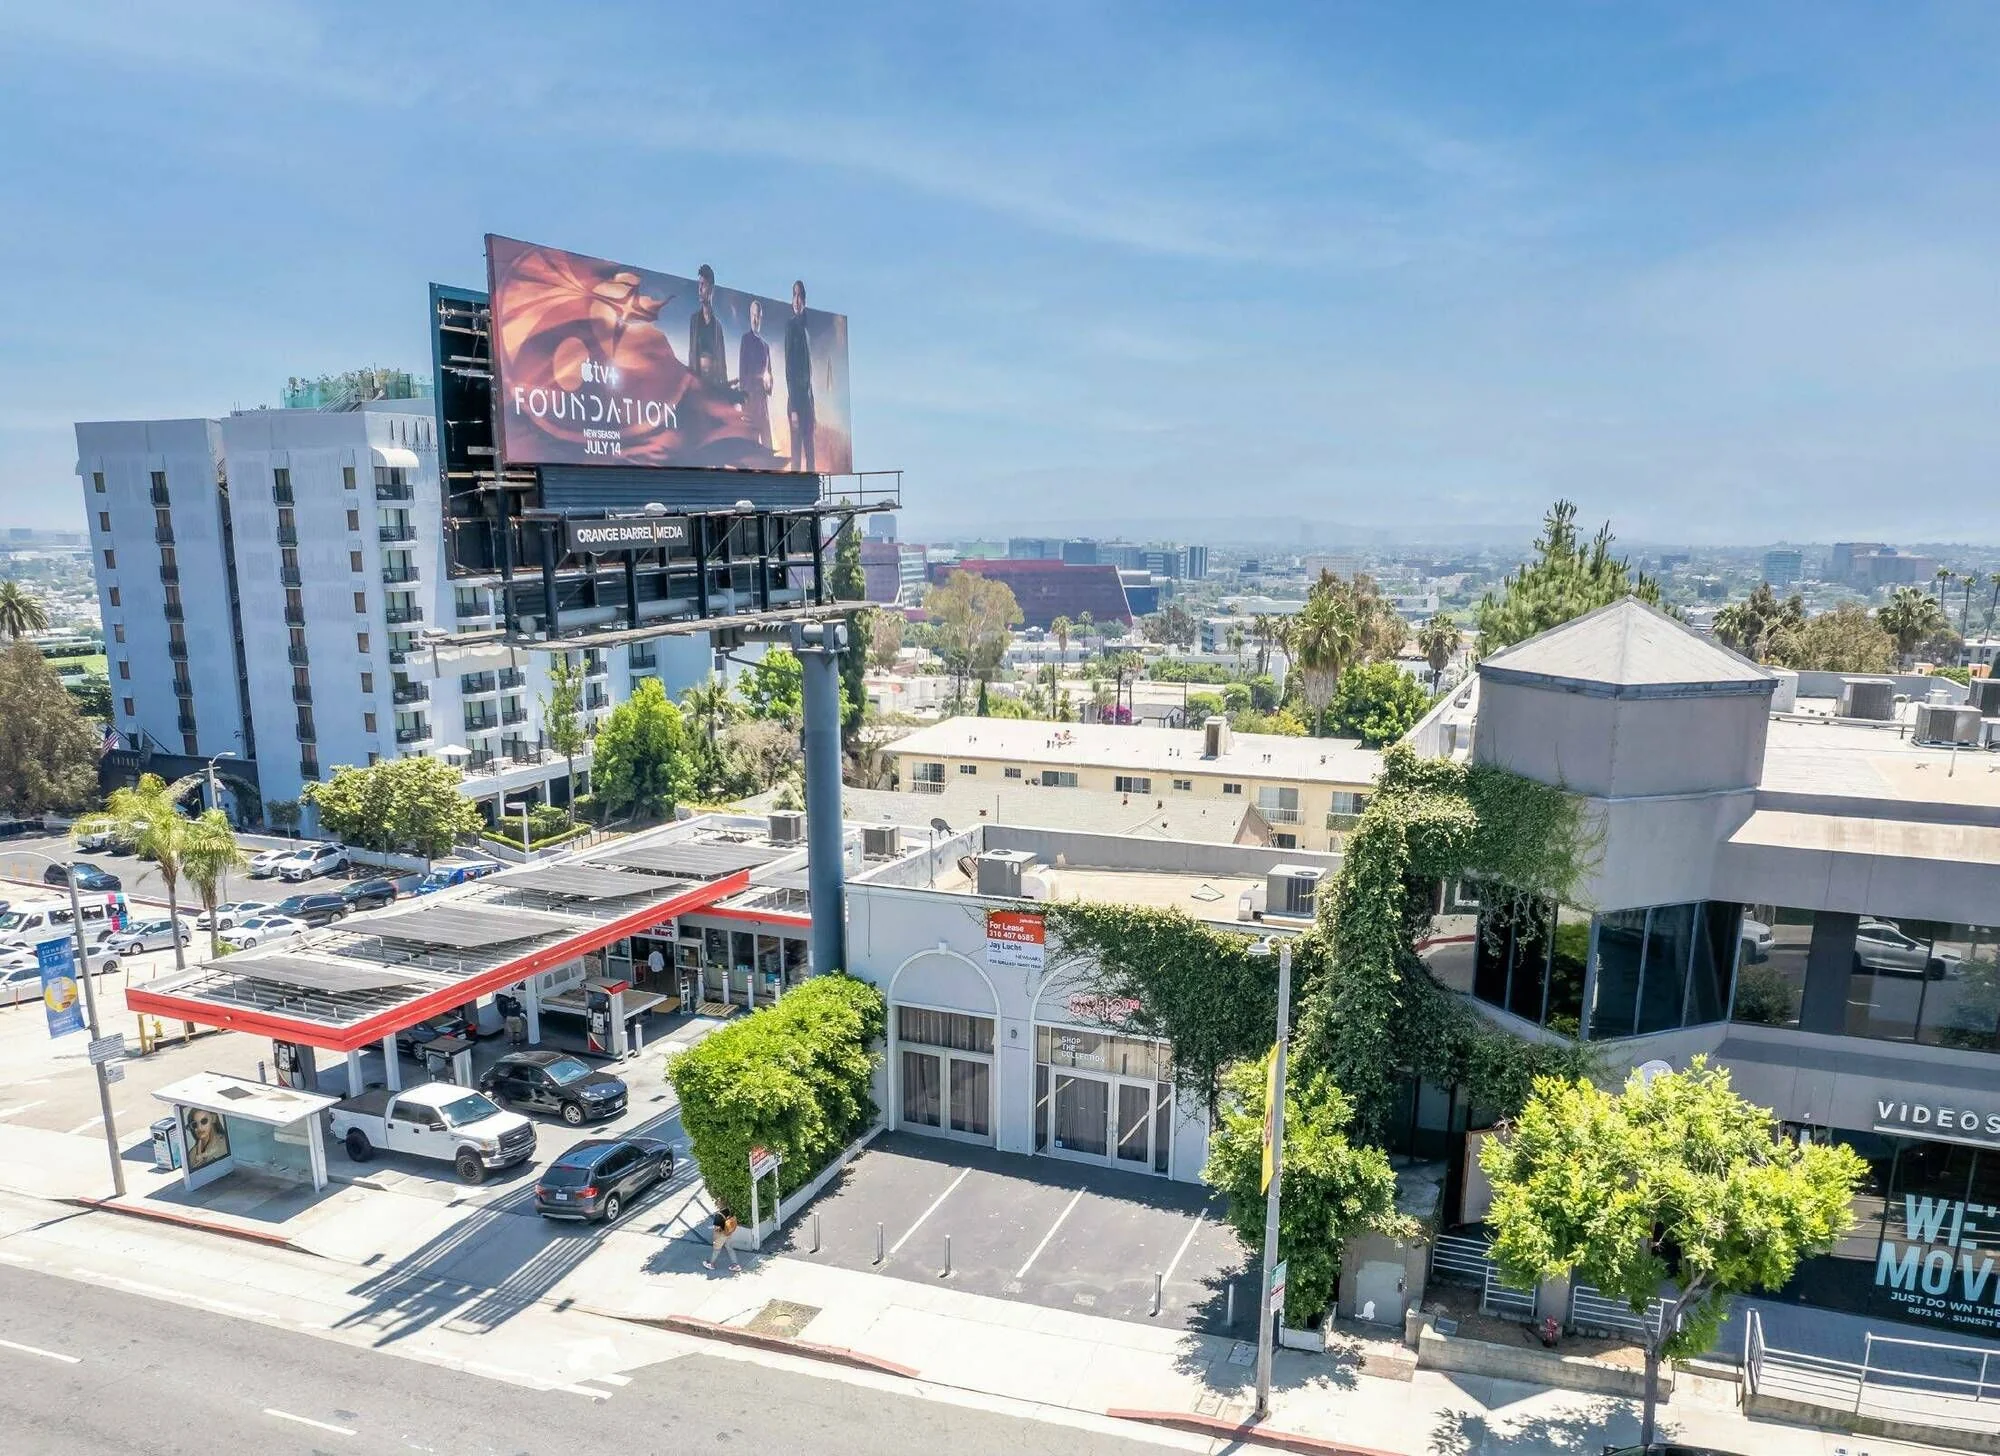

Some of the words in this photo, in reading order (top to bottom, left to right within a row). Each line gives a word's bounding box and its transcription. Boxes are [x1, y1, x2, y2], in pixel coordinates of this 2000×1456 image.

[514, 387, 678, 428] FOUNDATION
[584, 429, 597, 438] NEW
[597, 430, 620, 440] SEASON
[584, 441, 608, 455] JULY
[610, 442, 621, 456] 14
[577, 528, 619, 543] ORANGE
[620, 527, 653, 540] BARREL
[657, 526, 683, 539] MEDIA
[990, 921, 1001, 929] For
[1002, 922, 1024, 932] Lease
[989, 930, 1002, 938] 310
[1017, 934, 1035, 942] 6585
[990, 941, 1000, 950] Jay
[1061, 1036, 1080, 1045] SHOP
[1061, 1050, 1104, 1063] COLLECTION
[1878, 1101, 2000, 1134] VIDEOS
[1875, 1241, 2000, 1306] MOV
[1891, 1291, 1924, 1305] JUST
[1908, 1307, 1932, 1317] 8873
[1953, 1315, 1994, 1327] SUNSET
